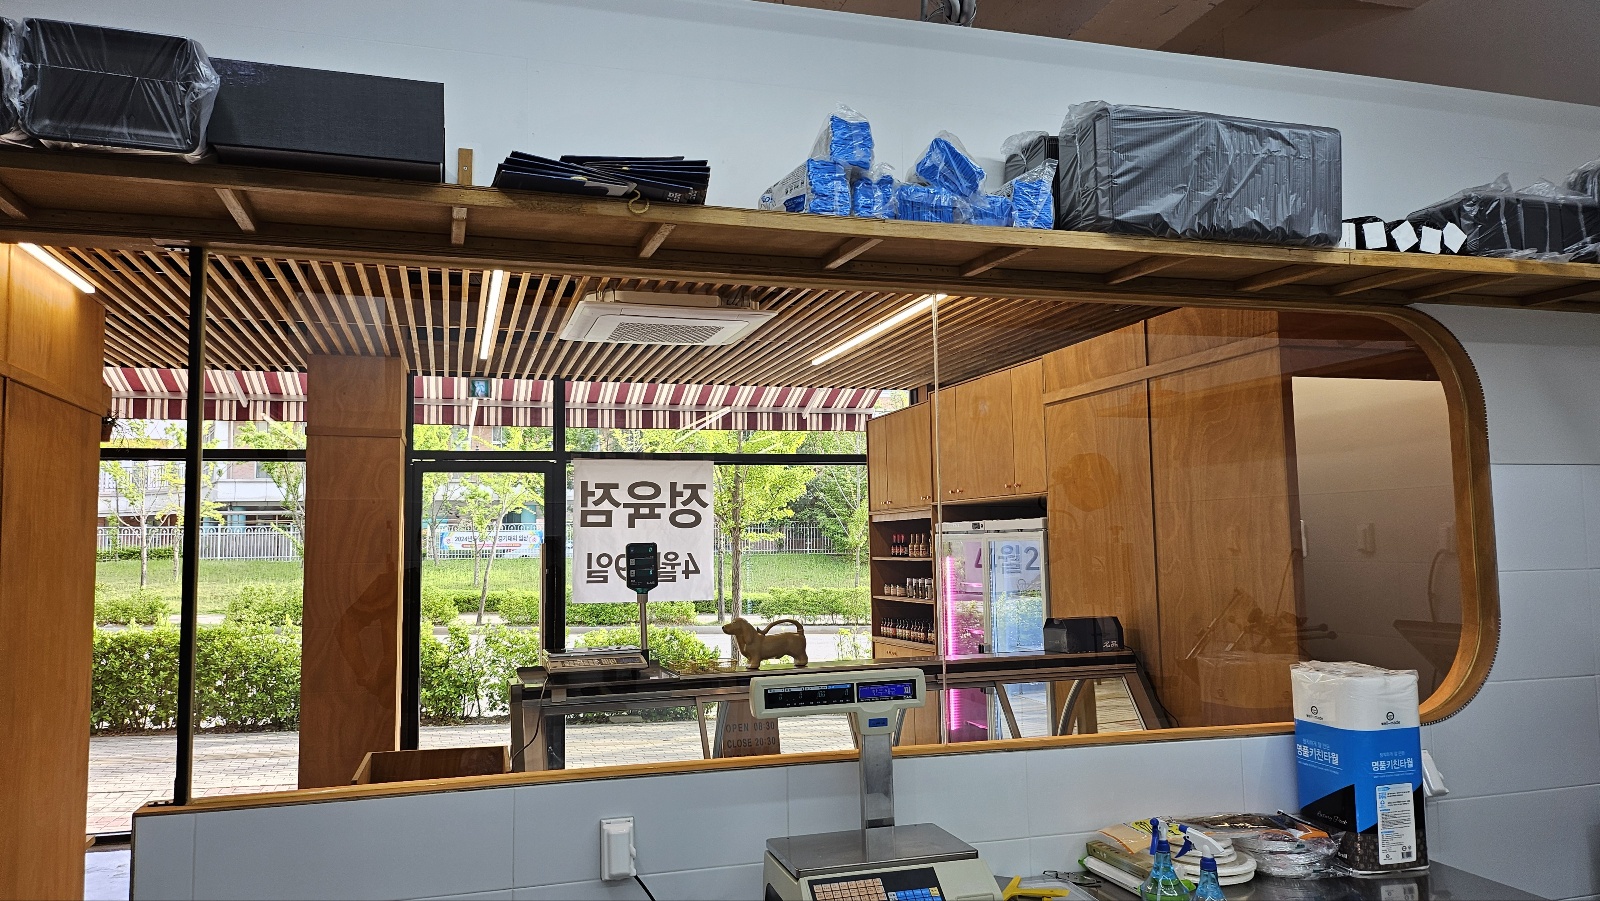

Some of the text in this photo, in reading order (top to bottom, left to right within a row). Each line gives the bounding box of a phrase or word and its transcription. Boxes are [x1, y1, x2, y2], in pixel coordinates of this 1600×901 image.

[725, 721, 775, 733] OPEN 08:30
[726, 736, 776, 749] CLOSE 20:30
[1296, 743, 1339, 766] 명품키친타월
[1371, 757, 1414, 772] 명품키친타월
